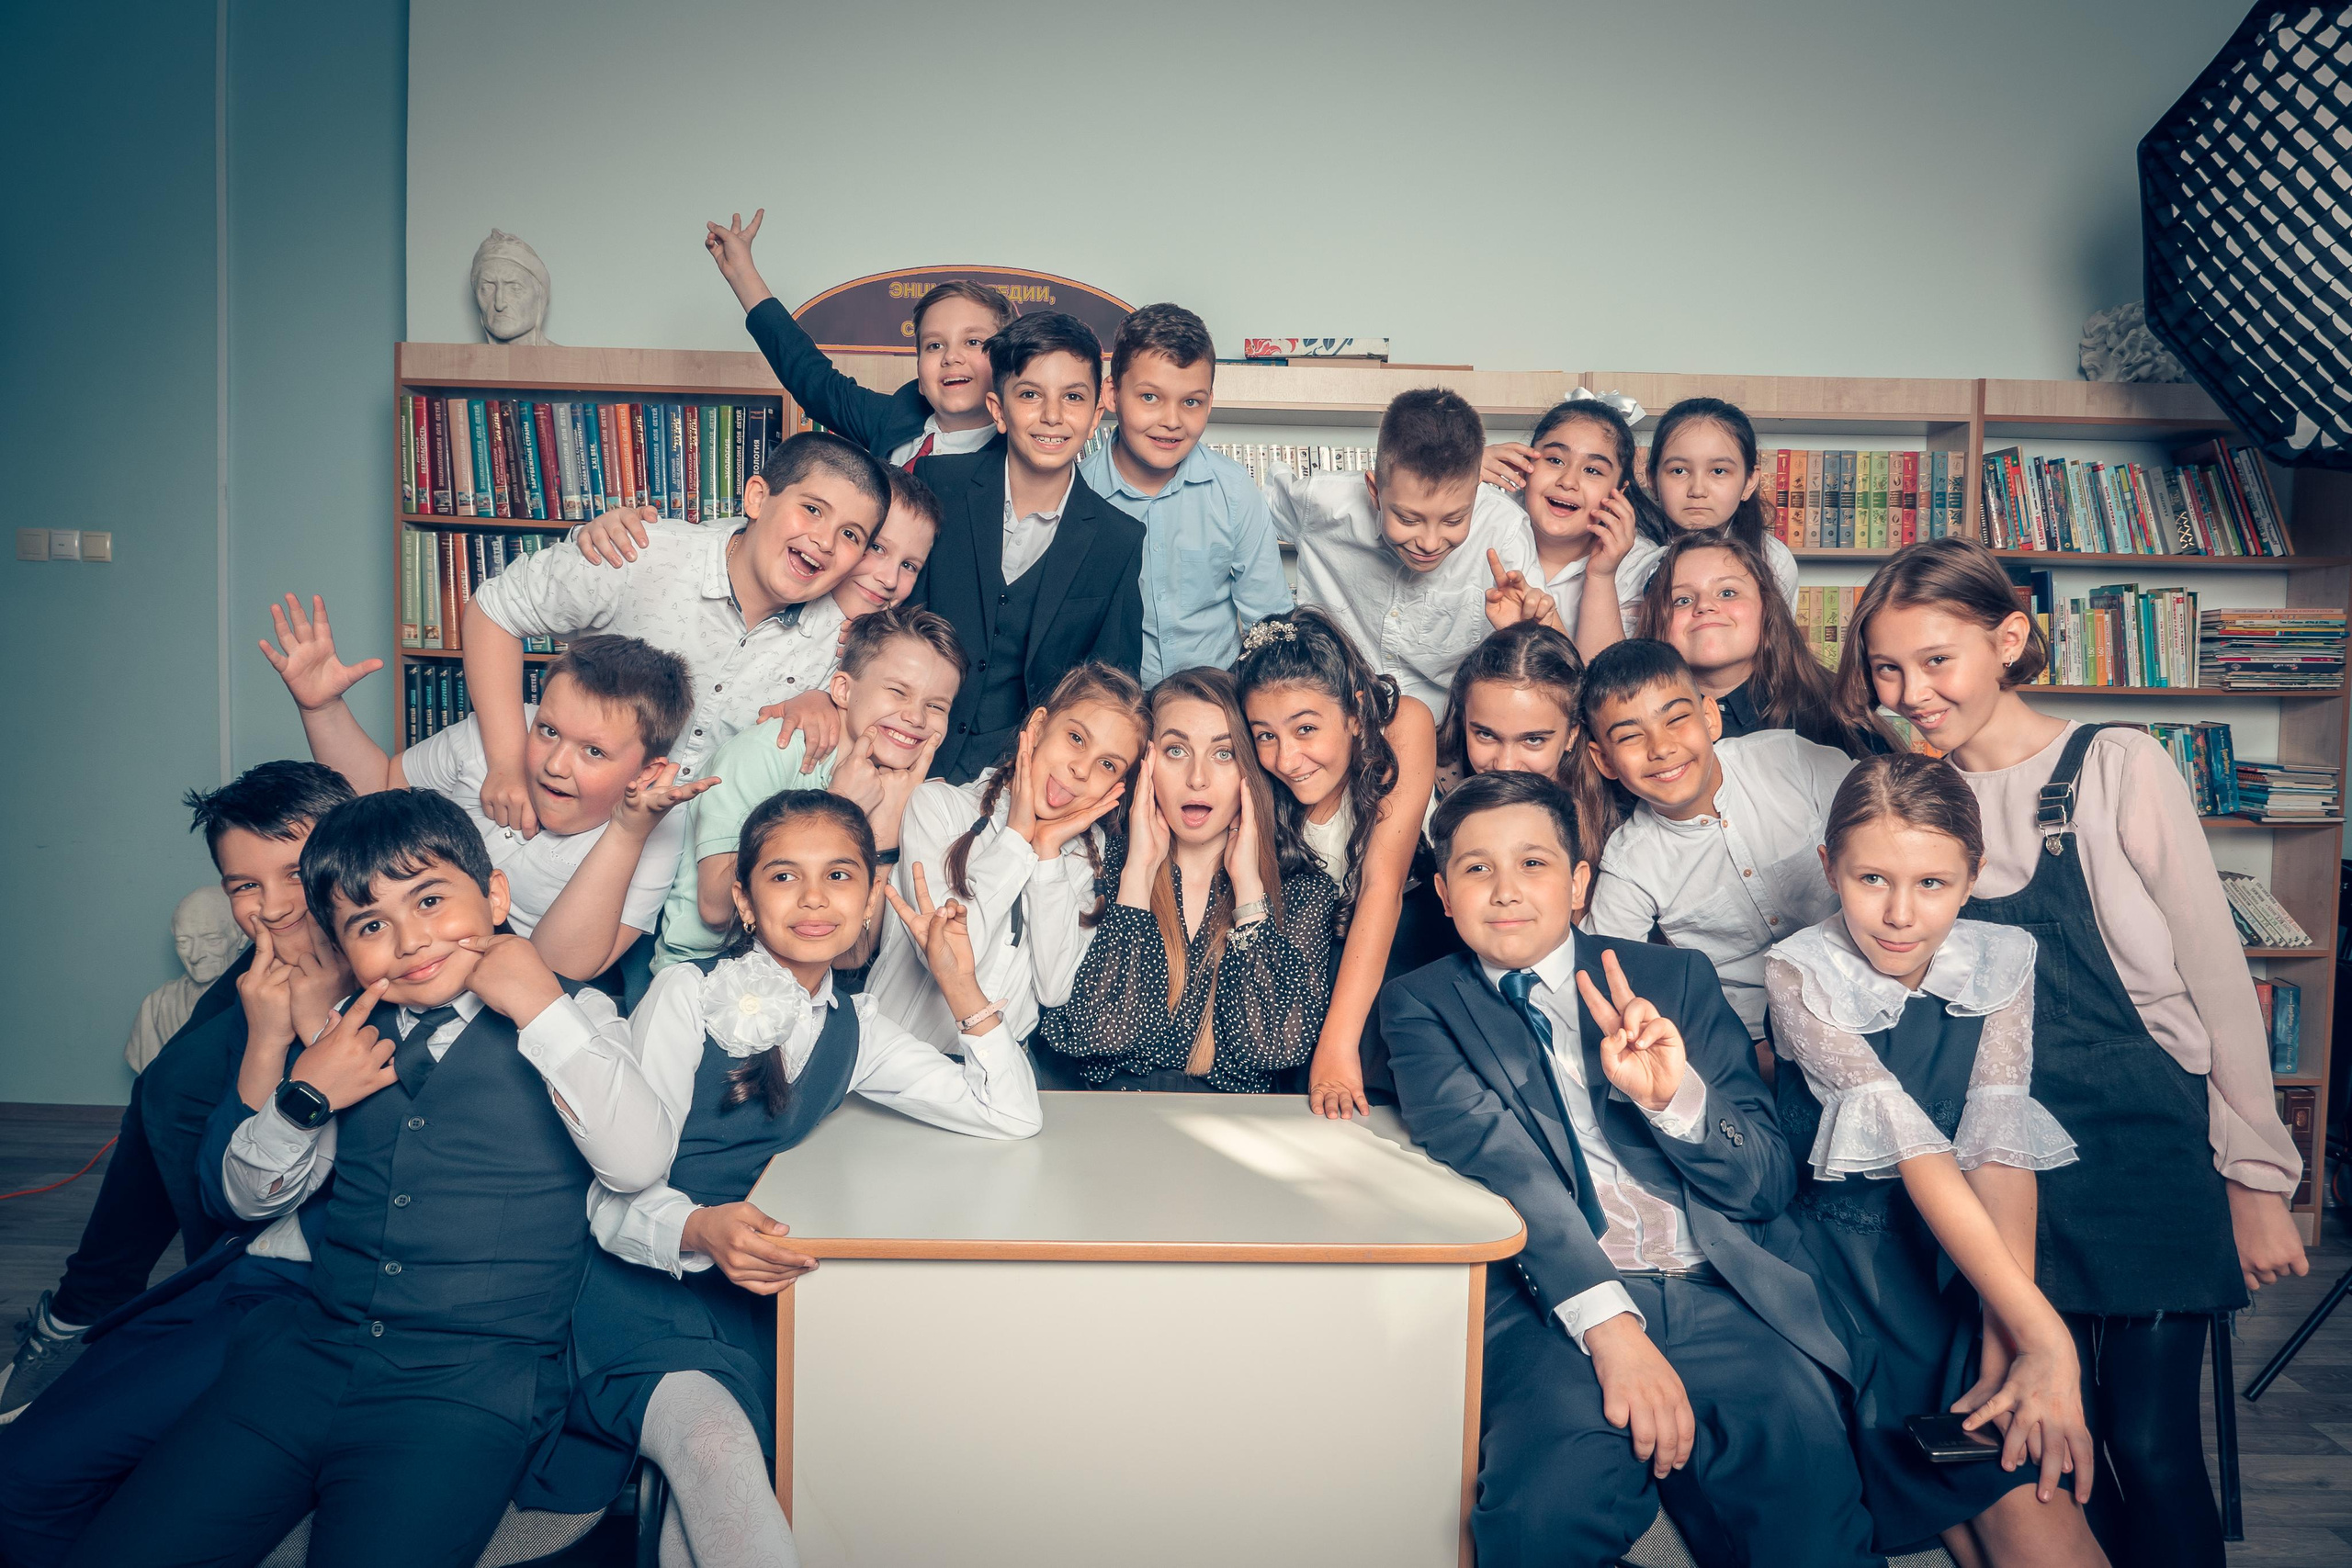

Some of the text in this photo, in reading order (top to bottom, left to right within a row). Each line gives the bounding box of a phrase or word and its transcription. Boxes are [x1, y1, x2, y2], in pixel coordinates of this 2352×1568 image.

[888, 281, 1057, 305] ЭНЦЕДИИ,
[599, 408, 607, 427] ДЕТЕЙ
[650, 408, 659, 427] ДЕТЕЙ
[524, 421, 532, 446] СТРАНЫ
[527, 447, 537, 490] ЗАРУБЕЖНЫЕ
[492, 540, 501, 564] ДЕТЕЙ
